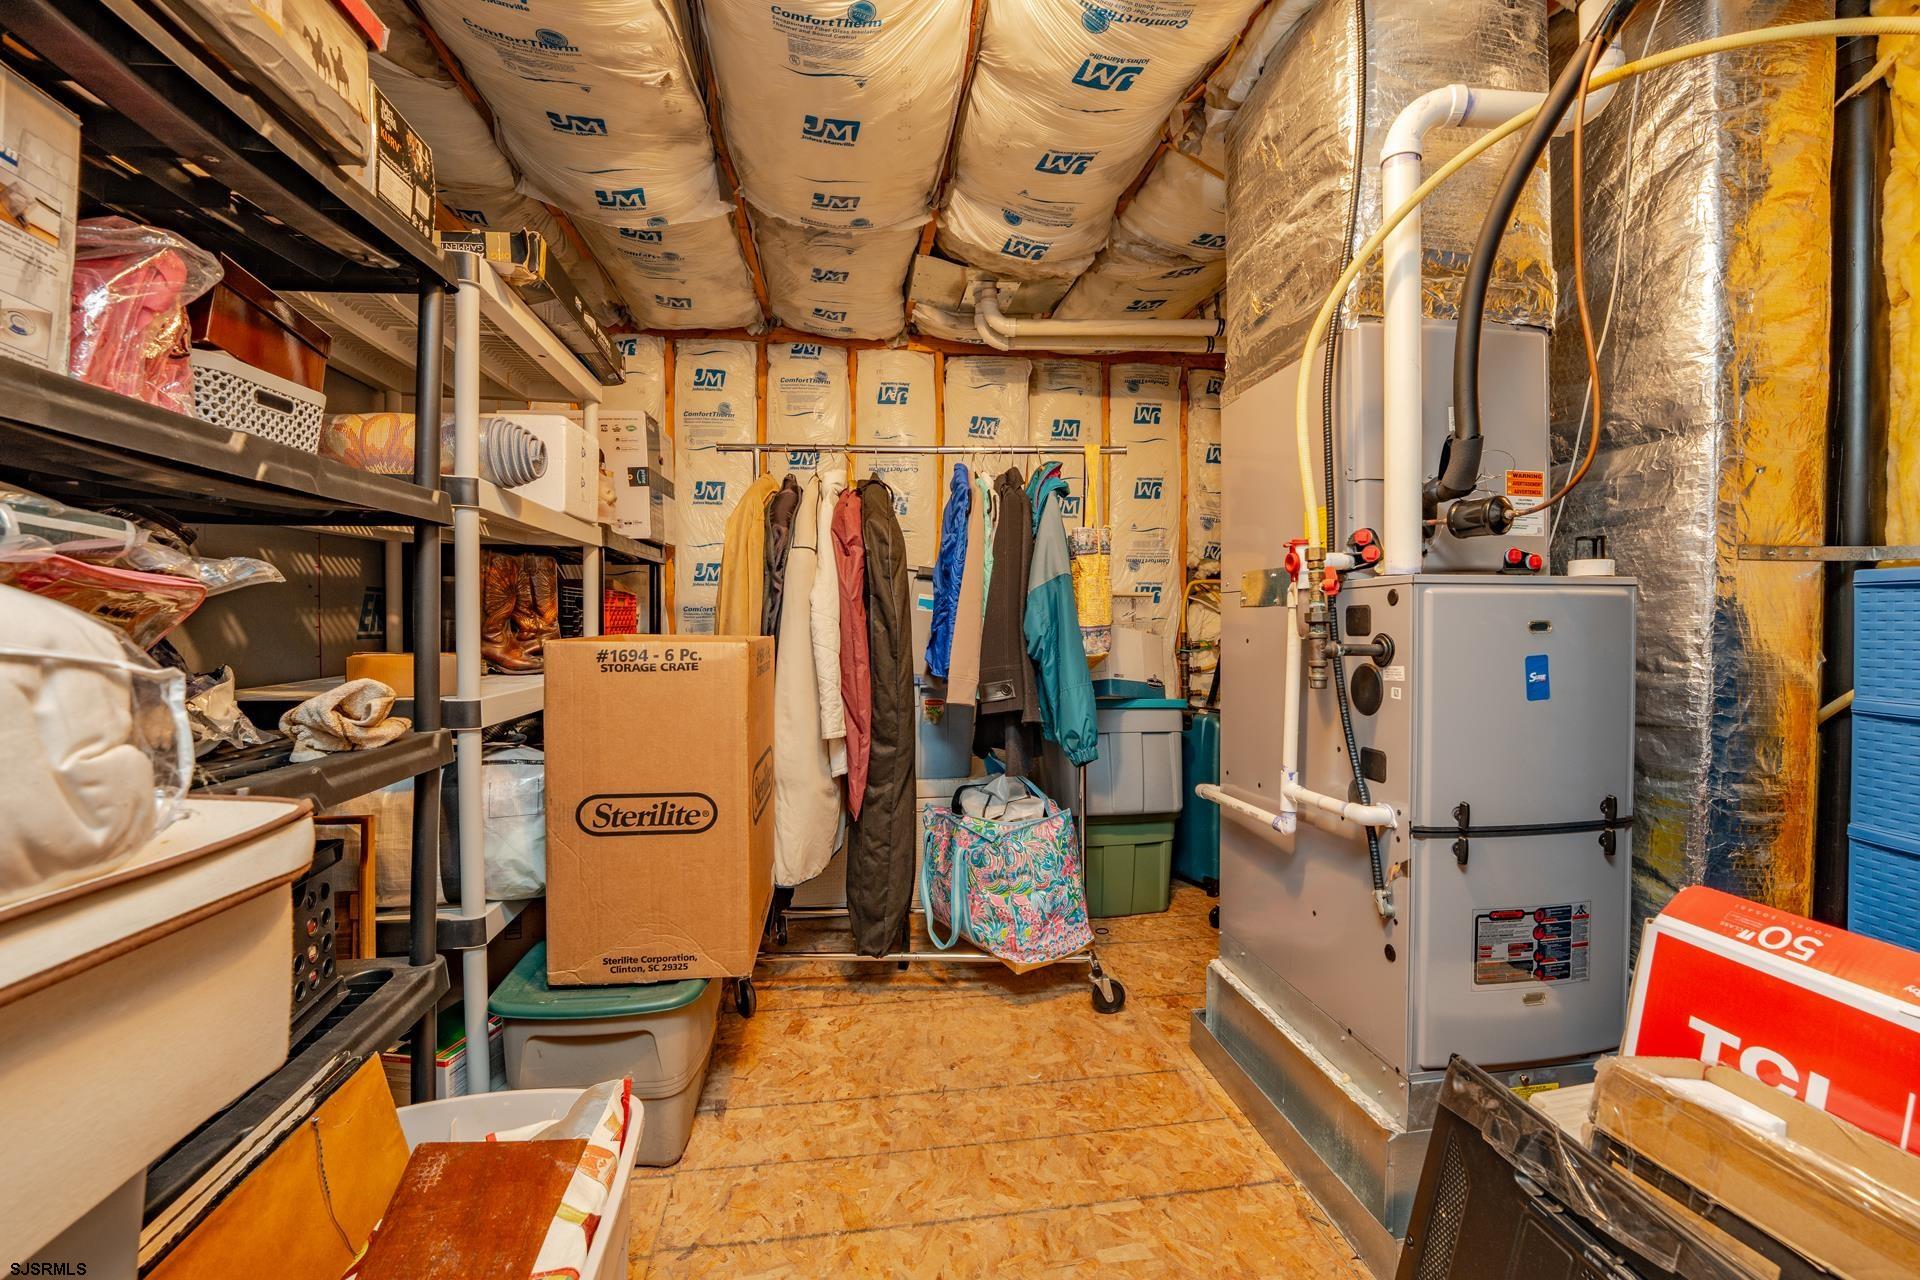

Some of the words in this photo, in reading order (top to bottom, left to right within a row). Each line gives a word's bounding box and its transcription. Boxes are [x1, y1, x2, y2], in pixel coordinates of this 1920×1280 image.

[770, 5, 882, 29] ComfortTherm
[462, 17, 580, 53] ComfortTherm
[1072, 59, 1144, 91] JM
[546, 111, 608, 134] JM
[803, 114, 860, 142] JM
[1035, 153, 1095, 174] JM
[595, 188, 646, 207] JM
[812, 192, 860, 209] JM
[1001, 238, 1050, 260] JM
[655, 294, 692, 310] JM
[694, 368, 726, 387] JM
[780, 377, 830, 385] ComfortTherm
[877, 386, 908, 404] JM
[683, 410, 735, 418] ComfortTherm
[1133, 406, 1161, 424] JM
[969, 415, 1000, 435] JM
[1051, 419, 1080, 437] JM
[694, 481, 726, 500] JM
[1134, 481, 1162, 499] JM
[596, 649, 648, 663] #1694
[664, 649, 674, 661] 6
[680, 648, 702, 661] Pc.
[600, 663, 656, 673] STORAGE
[660, 662, 699, 671] CRATE
[602, 956, 638, 966] Sterilite
[640, 953, 698, 964] Corporation,
[610, 965, 645, 974] Clinton,
[662, 963, 689, 971] 29325
